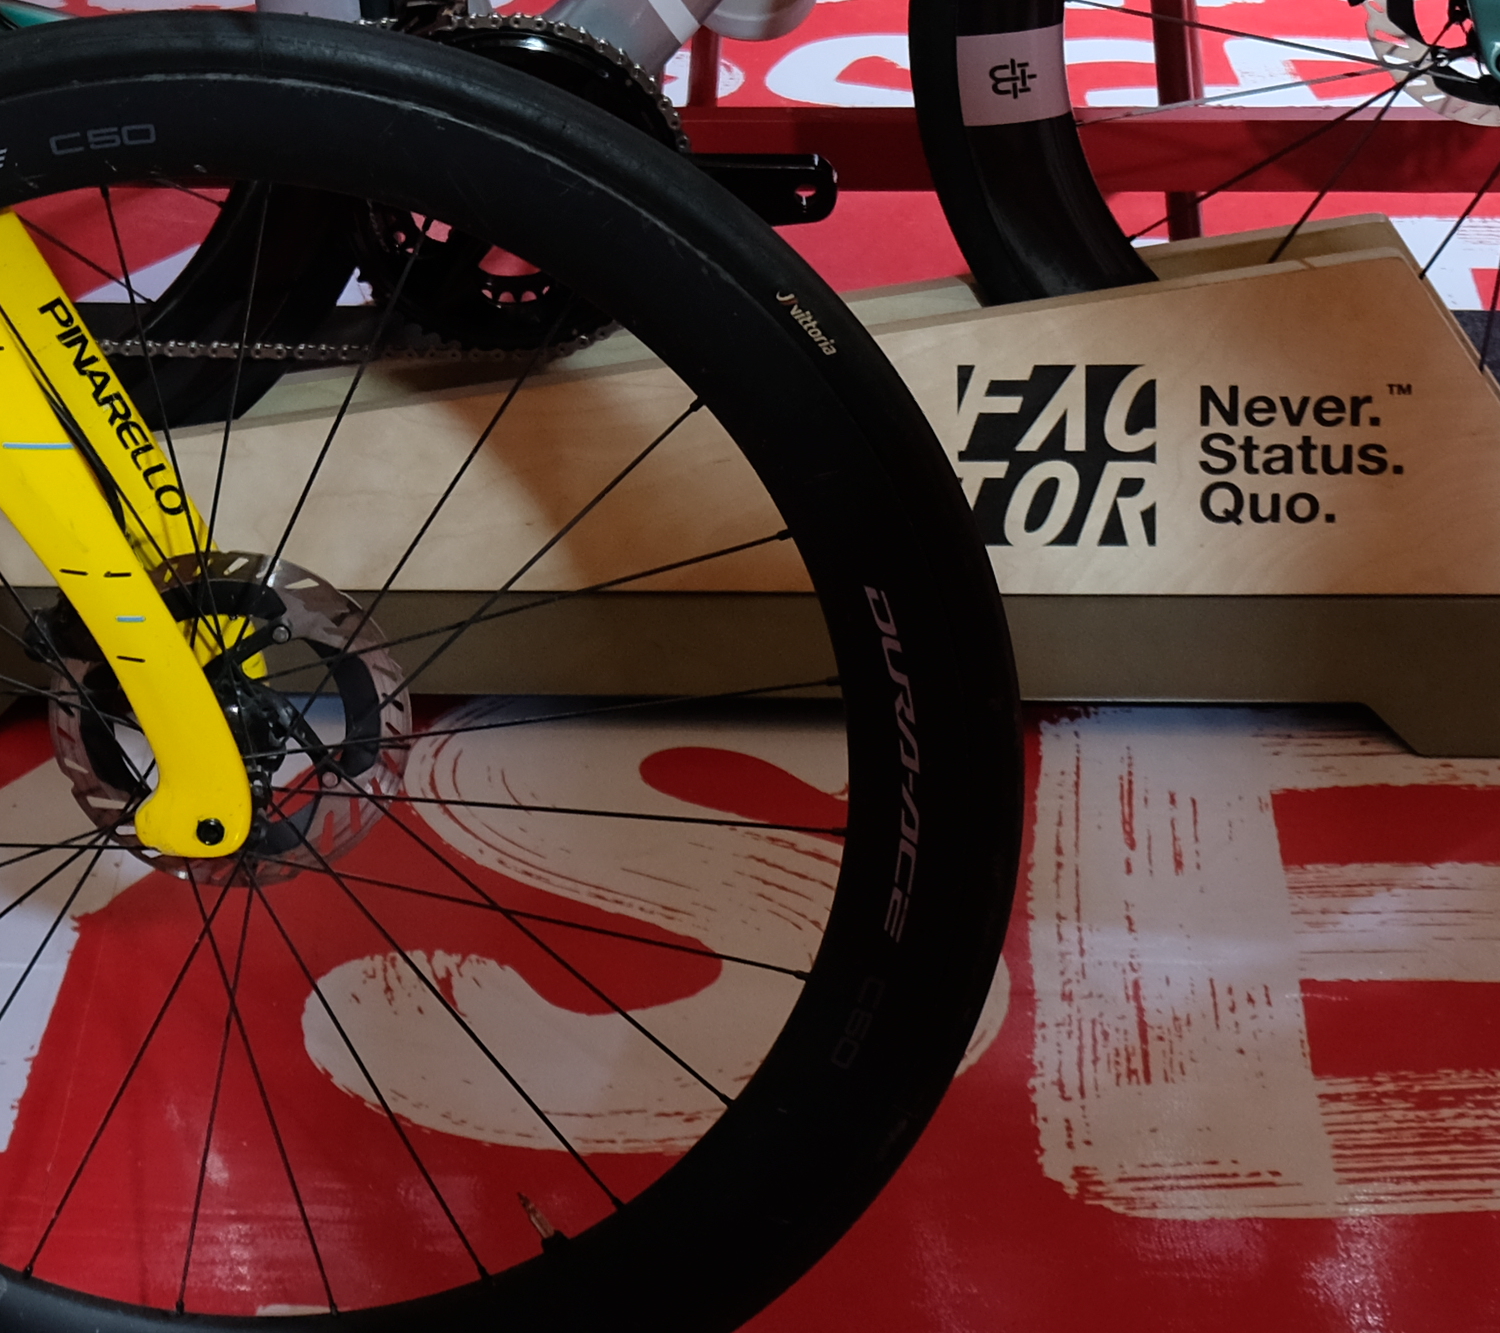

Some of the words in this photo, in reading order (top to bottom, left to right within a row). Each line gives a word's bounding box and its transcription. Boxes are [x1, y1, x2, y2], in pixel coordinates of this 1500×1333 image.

[48, 122, 157, 159] C50
[788, 302, 837, 358] vittoria
[37, 296, 187, 518] PINARELLO
[1199, 384, 1381, 428] Never.
[1198, 432, 1405, 476] Status.
[1199, 481, 1337, 525] Quo.
[863, 583, 921, 945] DURA-ACE
